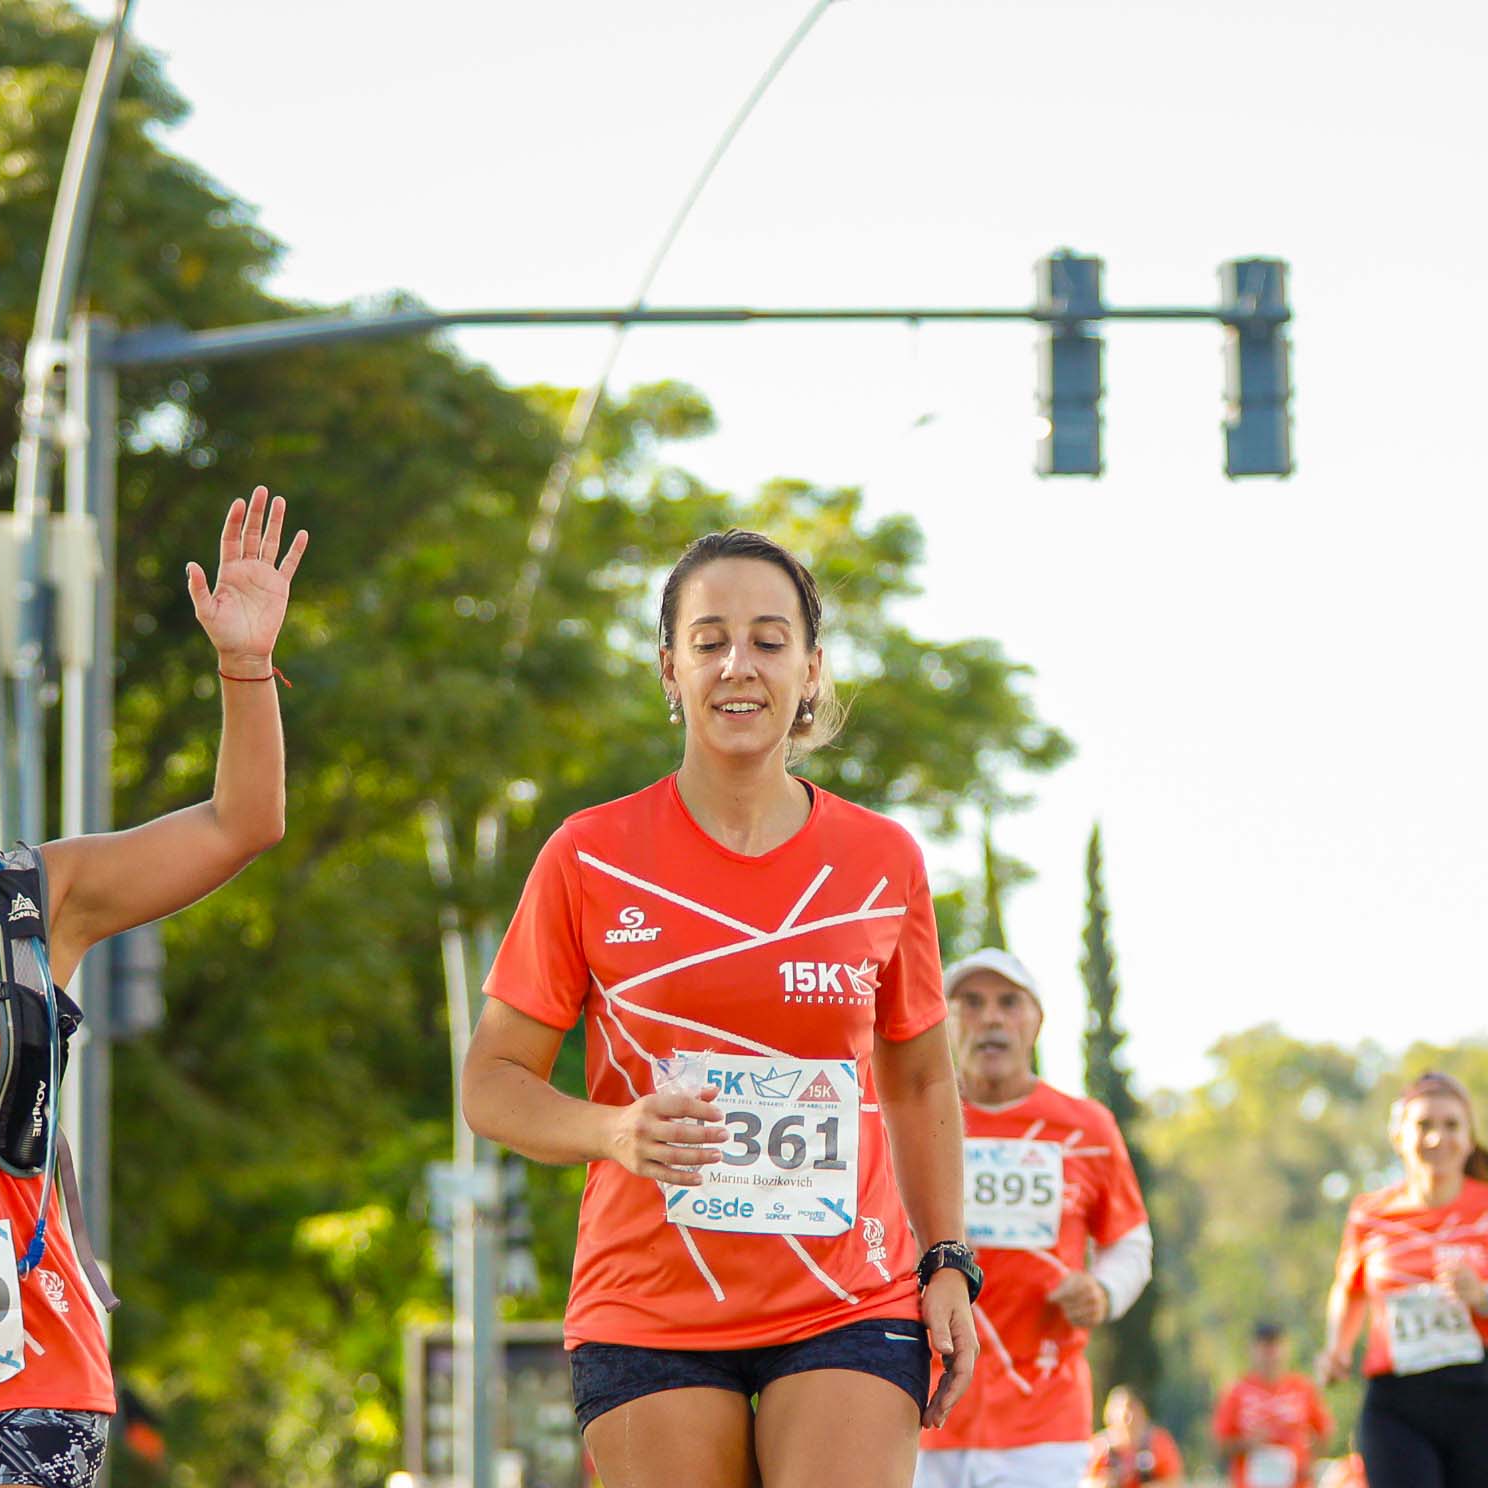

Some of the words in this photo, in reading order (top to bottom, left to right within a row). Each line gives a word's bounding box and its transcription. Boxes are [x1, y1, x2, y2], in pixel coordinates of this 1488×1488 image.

[778, 961, 845, 993] 15K
[784, 995, 844, 1004] PUERTO
[707, 1069, 745, 1095] 5K
[808, 1085, 833, 1098] 15K
[720, 1111, 847, 1170] 361
[709, 1172, 750, 1185] Marina
[753, 1174, 813, 1188] Bozikovich
[975, 1172, 1055, 1206] 895
[692, 1197, 754, 1220] osde
